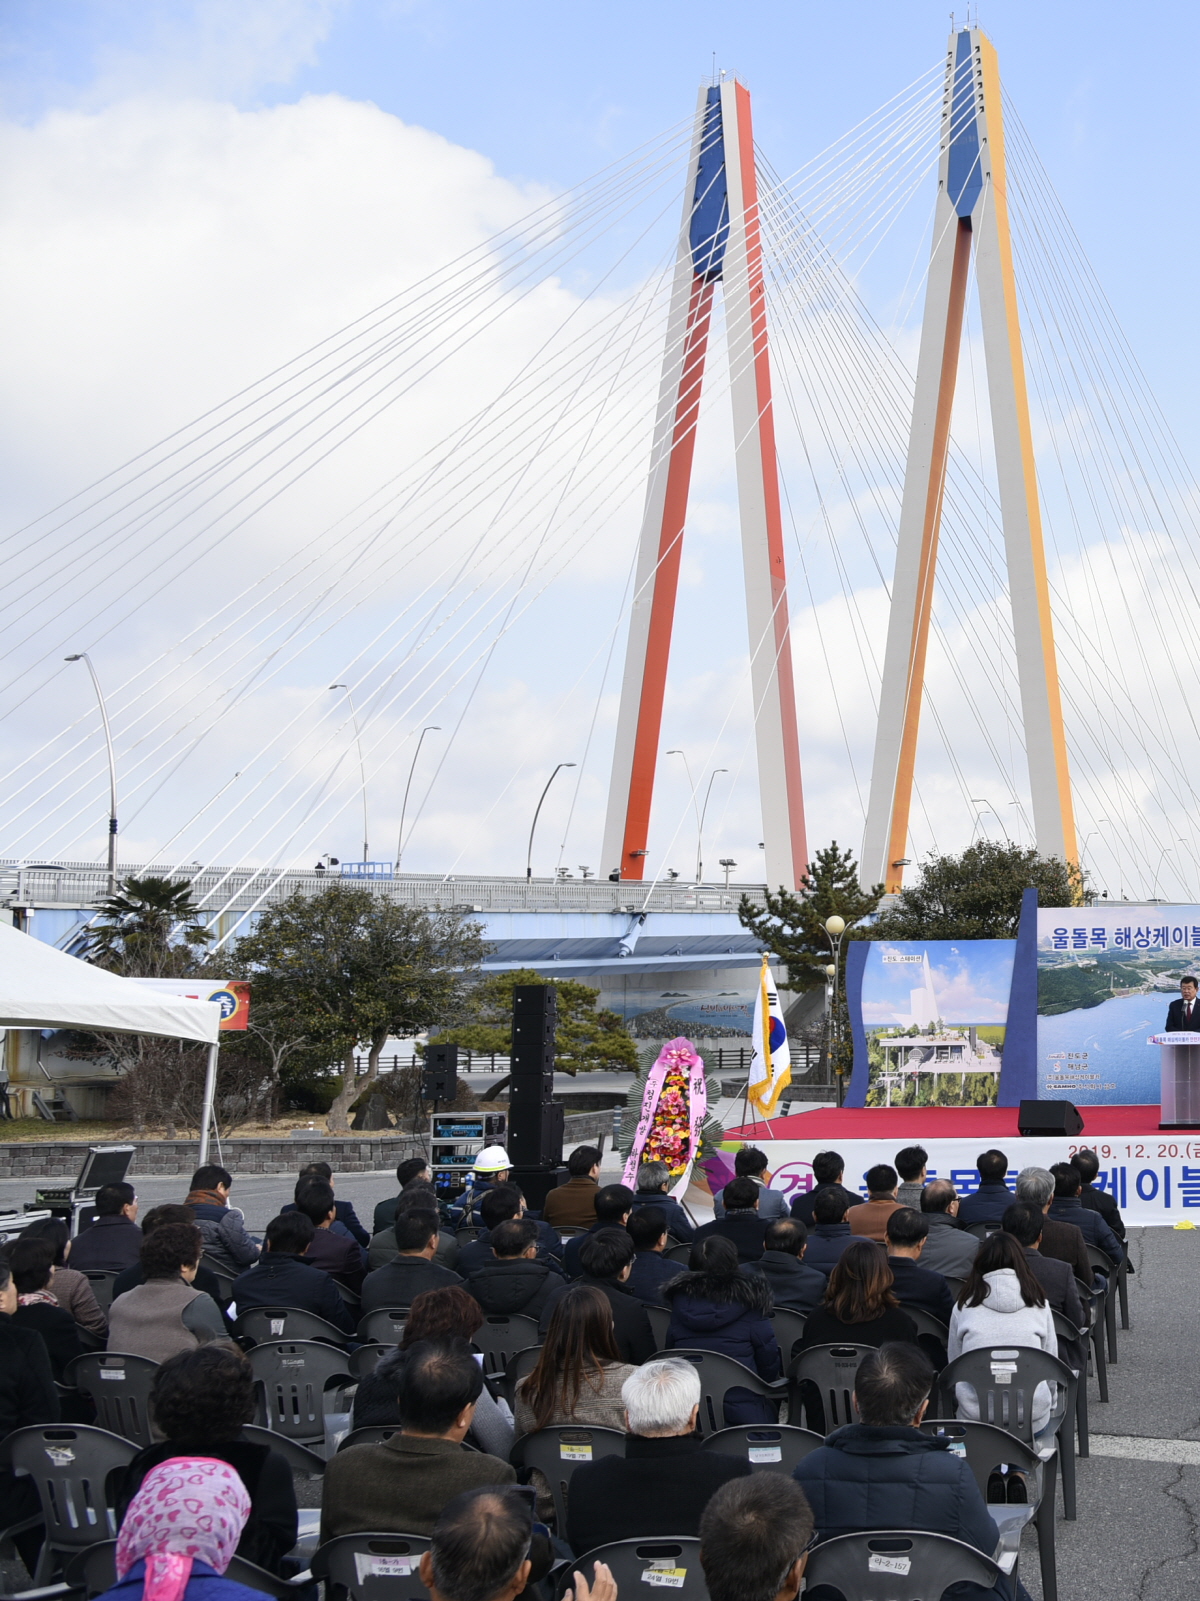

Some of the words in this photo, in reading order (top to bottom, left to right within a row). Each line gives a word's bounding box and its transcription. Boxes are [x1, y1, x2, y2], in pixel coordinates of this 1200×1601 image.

[1052, 927, 1107, 949] 울돌목
[1067, 1052, 1089, 1060] 진도군
[693, 1077, 704, 1095] 祝
[1125, 1144, 1151, 1159] 12.
